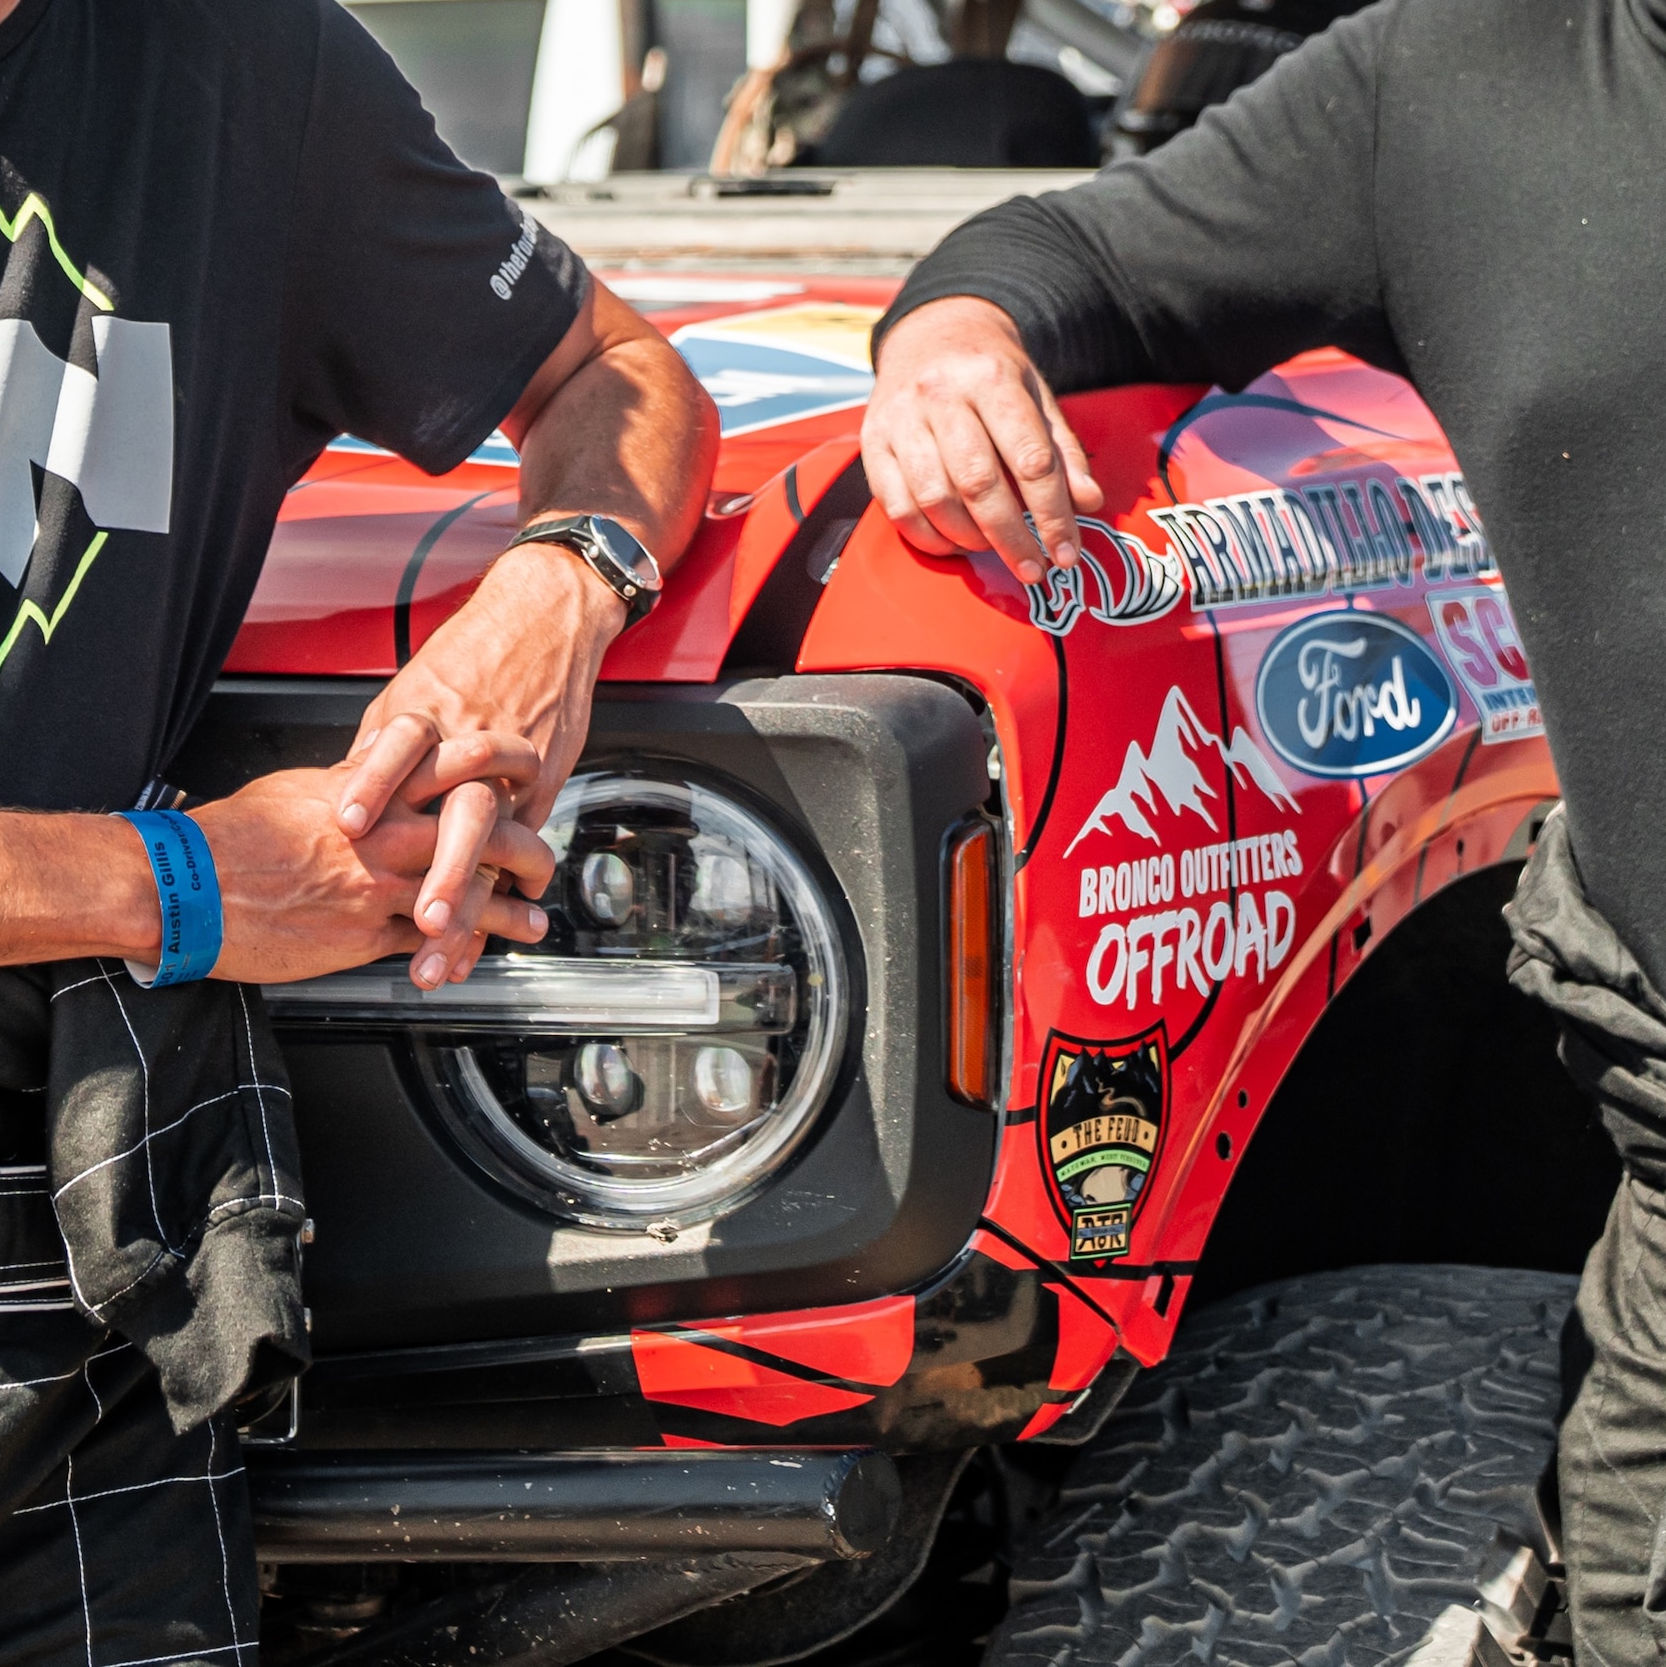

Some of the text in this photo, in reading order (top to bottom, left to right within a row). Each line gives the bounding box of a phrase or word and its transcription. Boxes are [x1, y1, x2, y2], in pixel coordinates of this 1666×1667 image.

[1149, 478, 1415, 611] ARMADILLO
[1296, 636, 1422, 750] Ford
[154, 840, 176, 887] Gillis
[1078, 828, 1304, 918] BRONCO OUTFITTERS
[167, 892, 182, 955] Austin
[1086, 890, 1297, 1011] OFFROAD
[1072, 1116, 1141, 1149] THE FEUD
